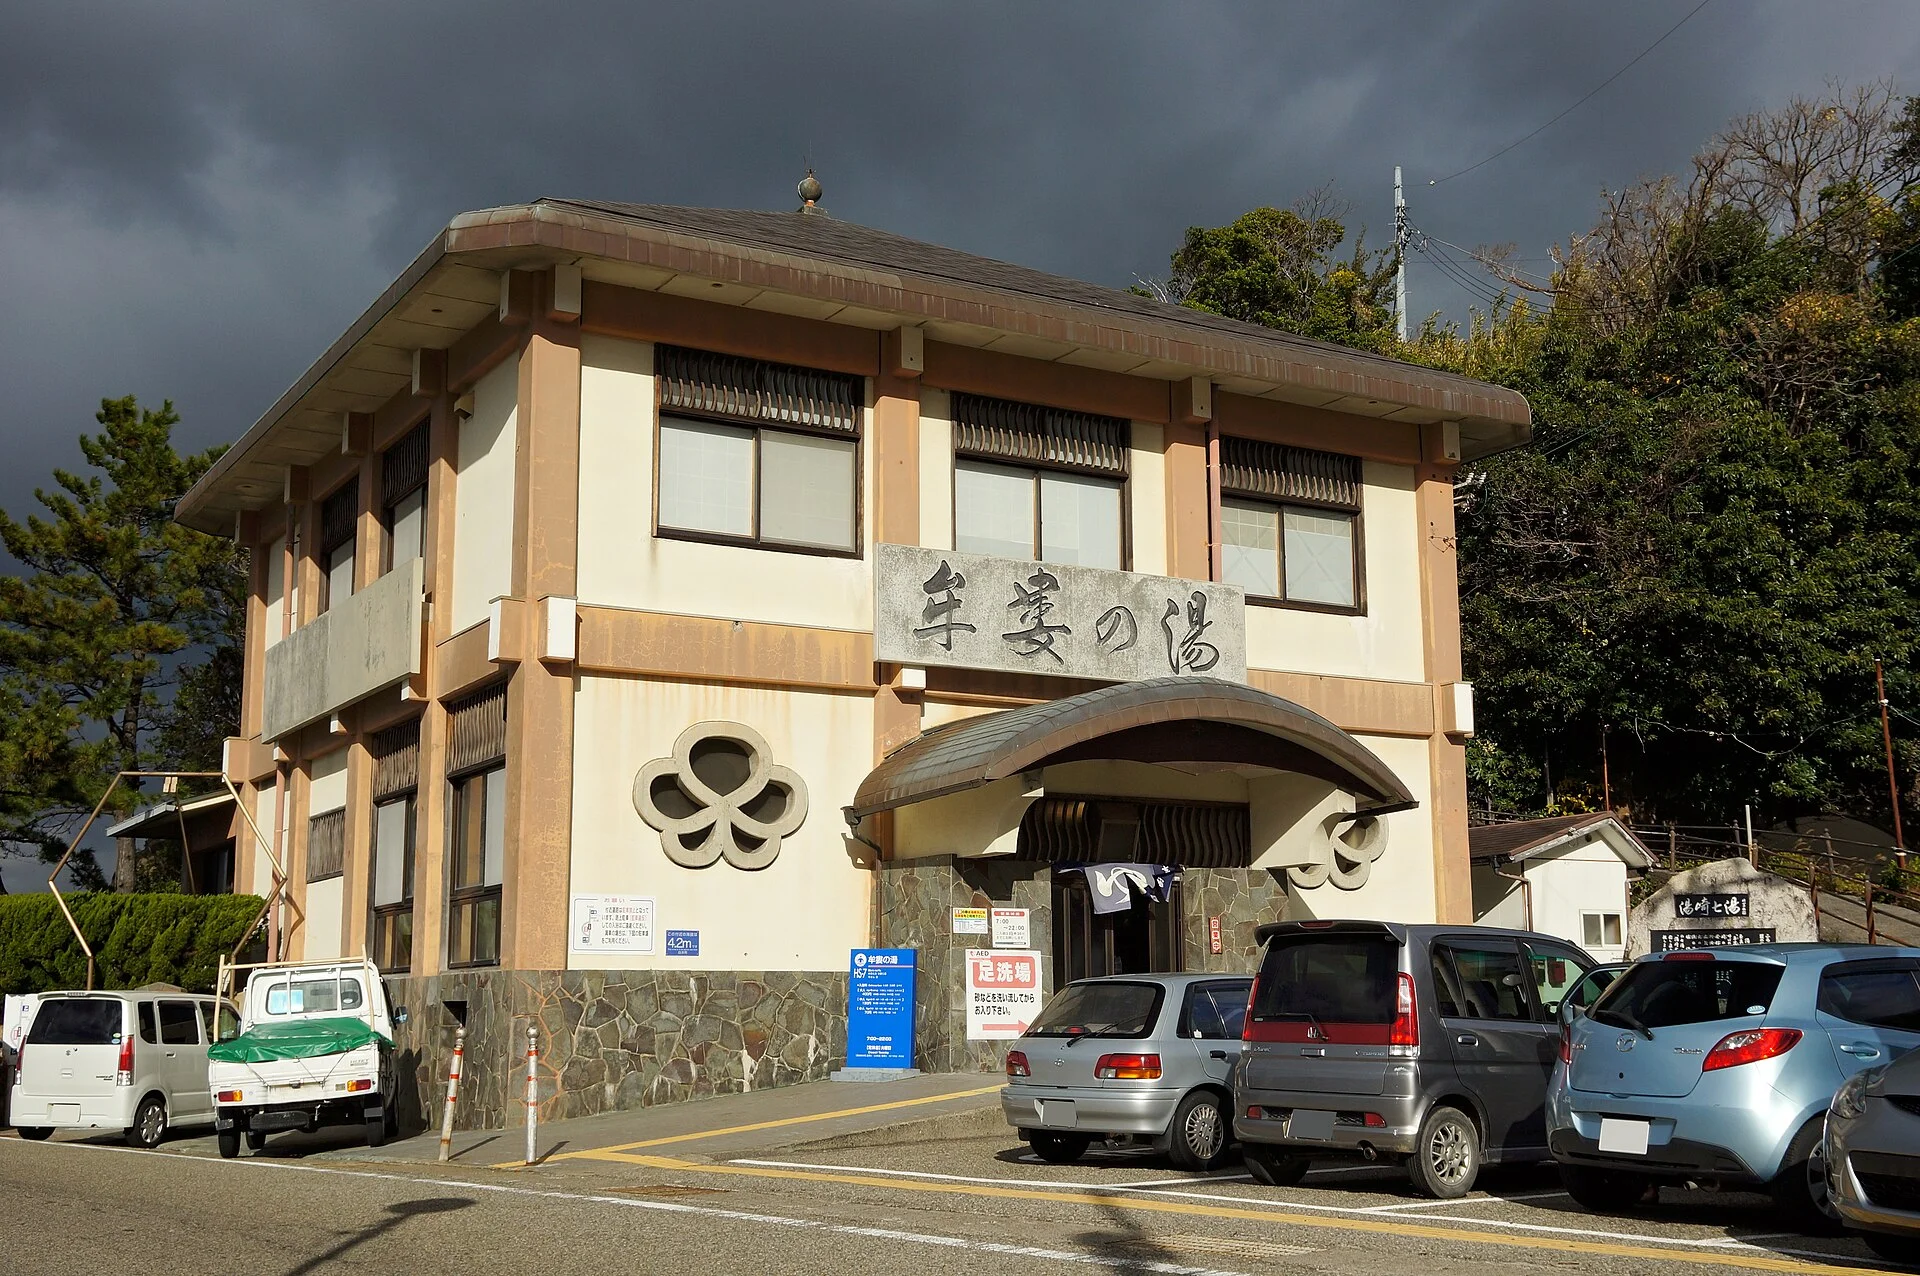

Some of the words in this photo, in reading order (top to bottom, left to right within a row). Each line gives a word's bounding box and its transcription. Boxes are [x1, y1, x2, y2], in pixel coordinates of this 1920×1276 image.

[912, 559, 1221, 675] 牟婁の湯
[1678, 896, 1741, 916] 湯崎七湯
